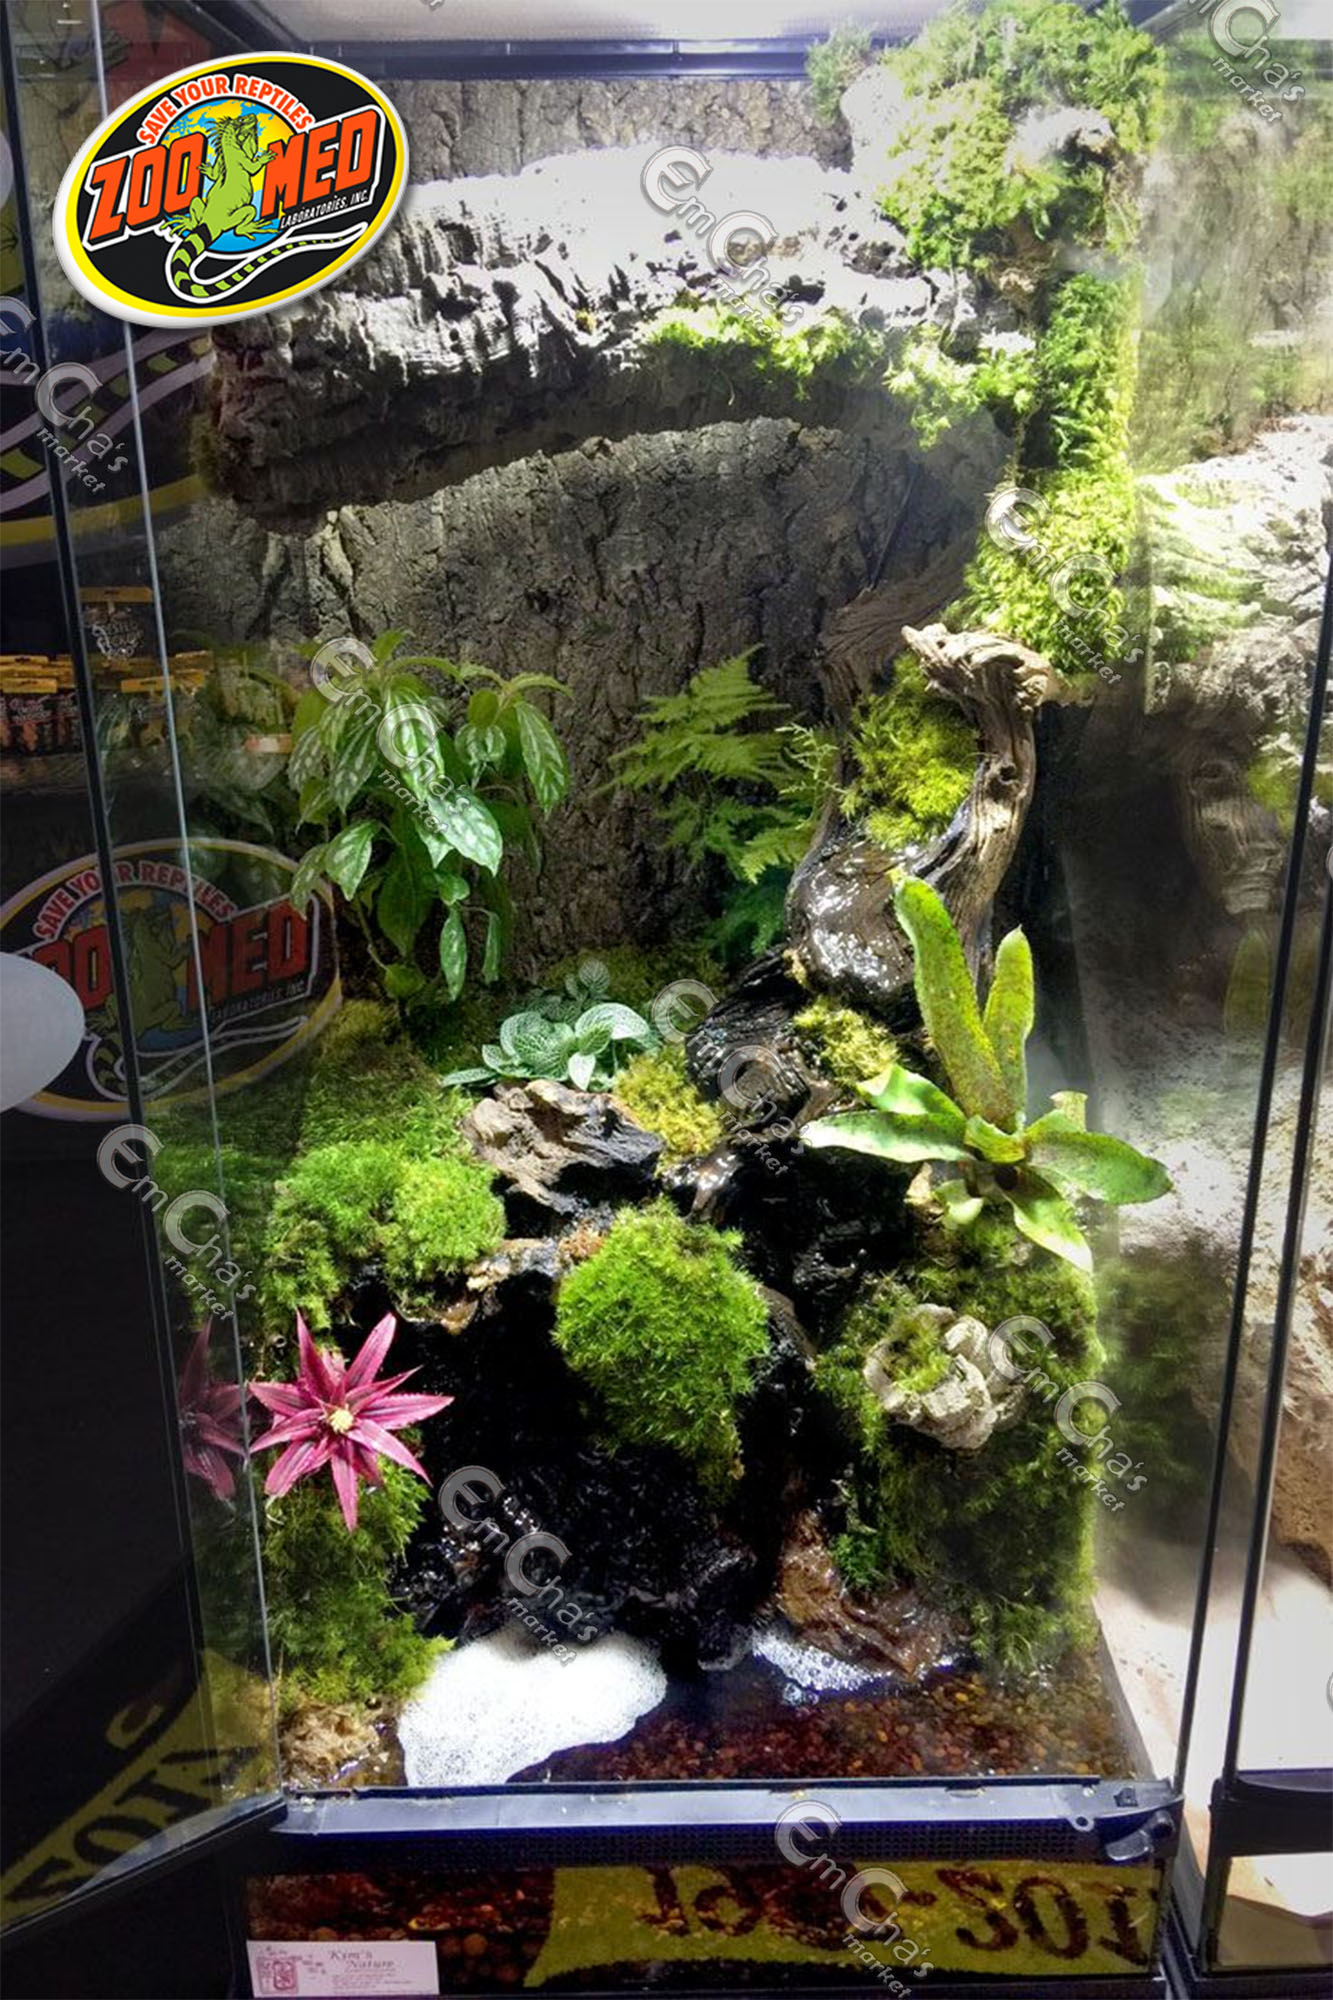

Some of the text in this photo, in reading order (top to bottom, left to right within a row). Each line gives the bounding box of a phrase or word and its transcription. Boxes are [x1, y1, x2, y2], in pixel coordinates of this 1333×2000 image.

[36, 889, 75, 940] SAVE
[71, 863, 135, 898] YOR
[187, 898, 308, 1012] MED
